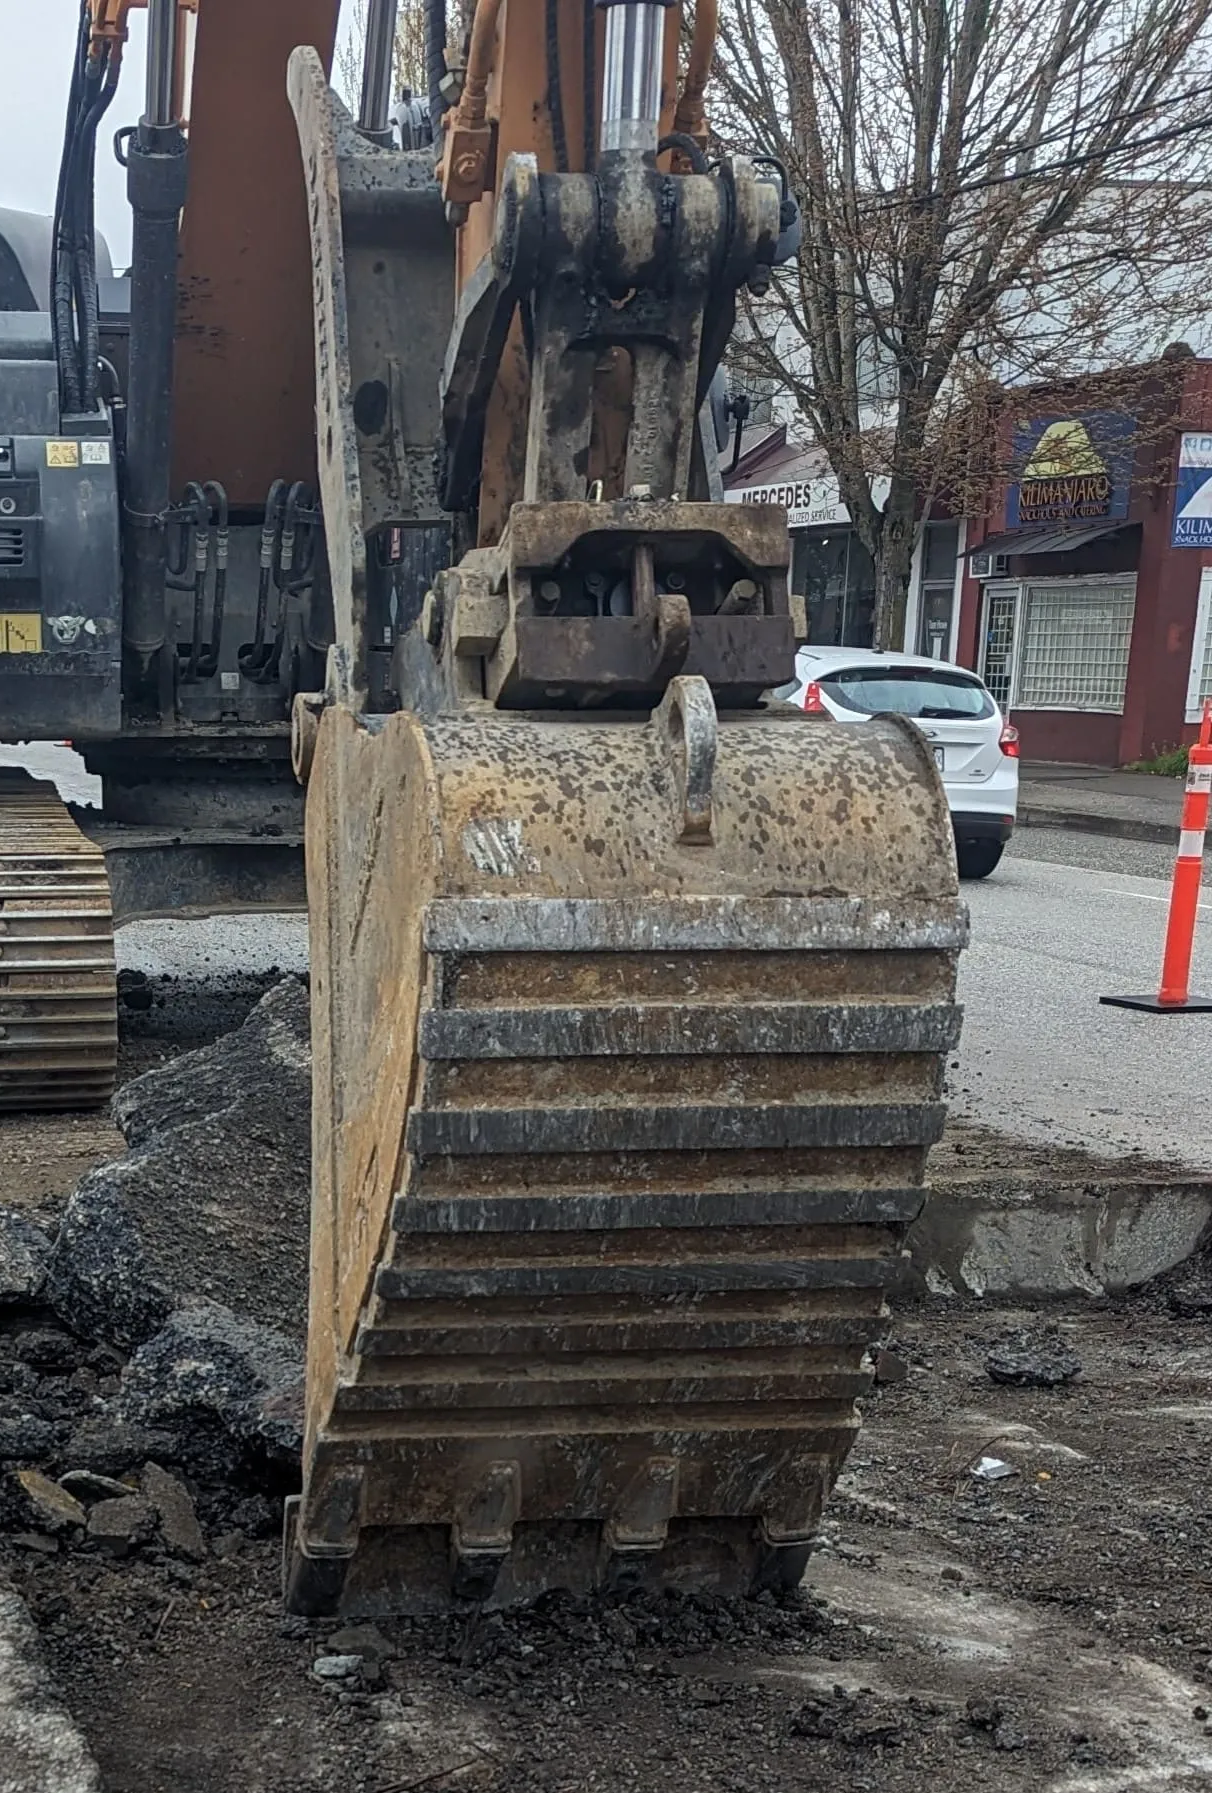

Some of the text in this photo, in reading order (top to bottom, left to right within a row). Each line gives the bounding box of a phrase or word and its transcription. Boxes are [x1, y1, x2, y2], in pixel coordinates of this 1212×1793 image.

[742, 484, 811, 508] MERCEDES
[787, 508, 837, 525] ALIZED SERVICE
